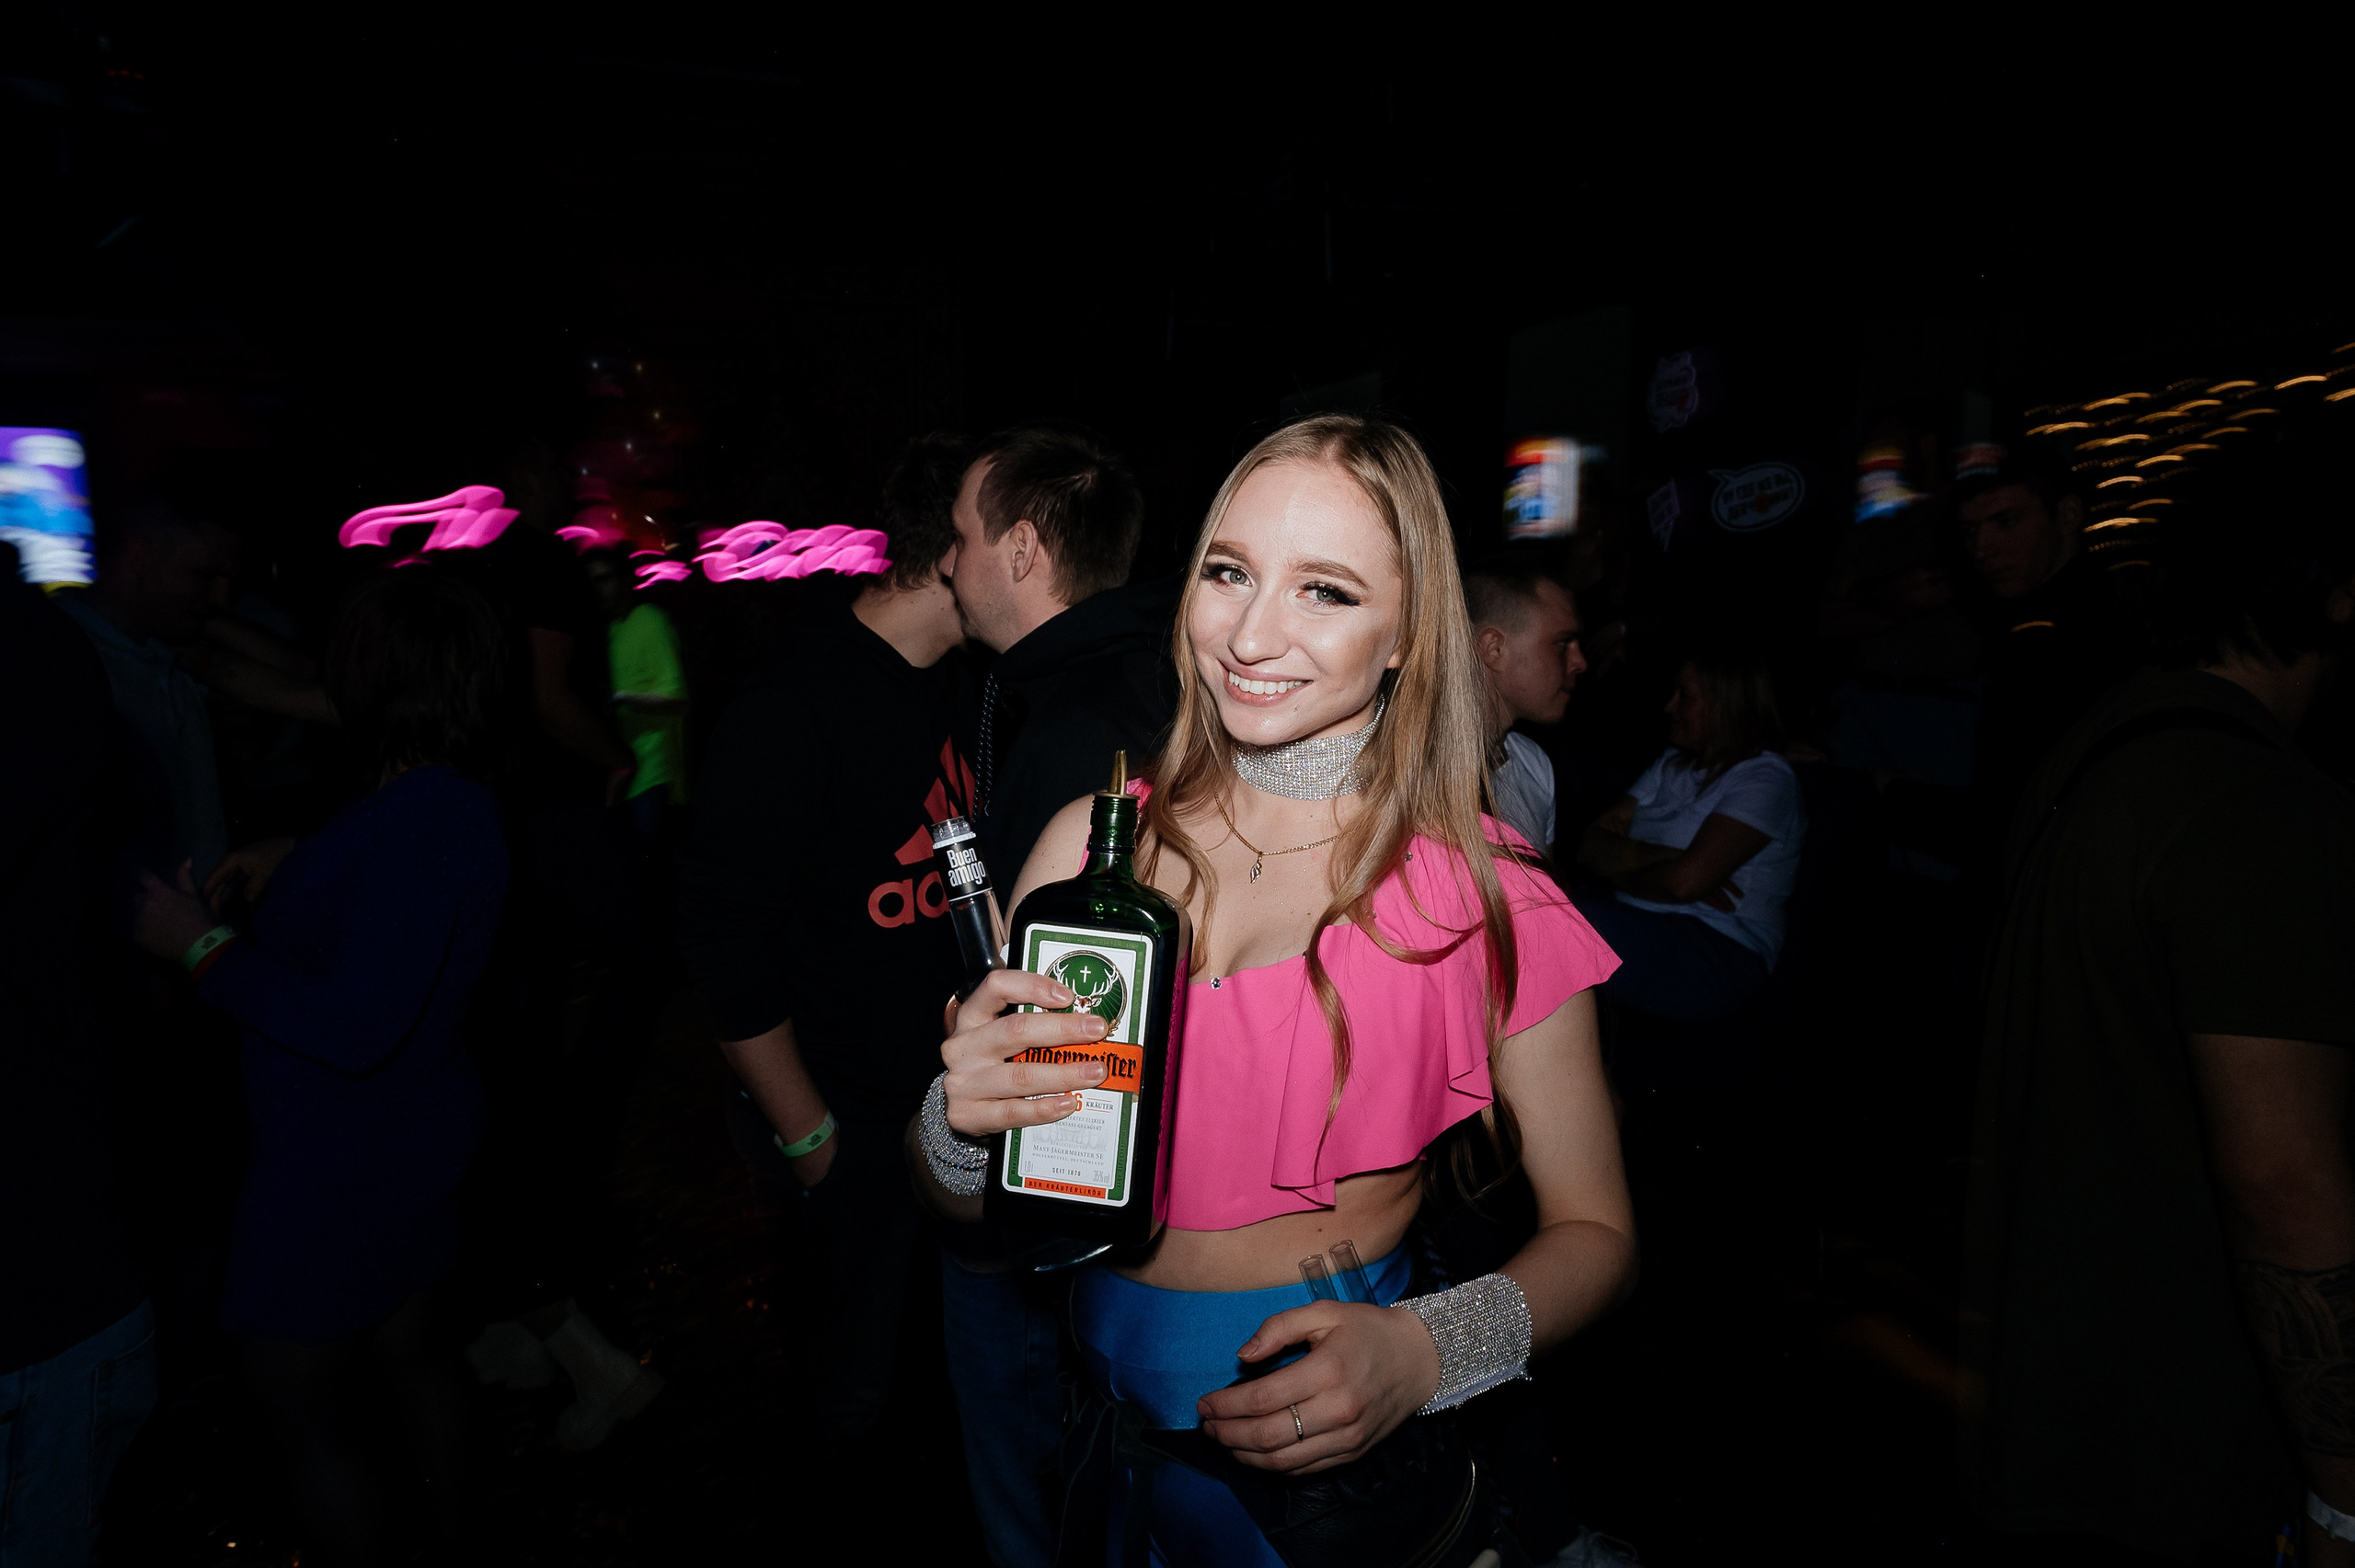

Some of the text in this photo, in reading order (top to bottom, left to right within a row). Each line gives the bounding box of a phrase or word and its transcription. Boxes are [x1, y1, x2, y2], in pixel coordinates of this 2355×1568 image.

[947, 847, 977, 868] Buen
[948, 861, 986, 887] amigo
[1086, 1101, 1114, 1110] KRÄUTER
[1067, 1169, 1081, 1177] 1878
[1028, 1180, 1101, 1196] DER KRÄUTERLIKÖR
